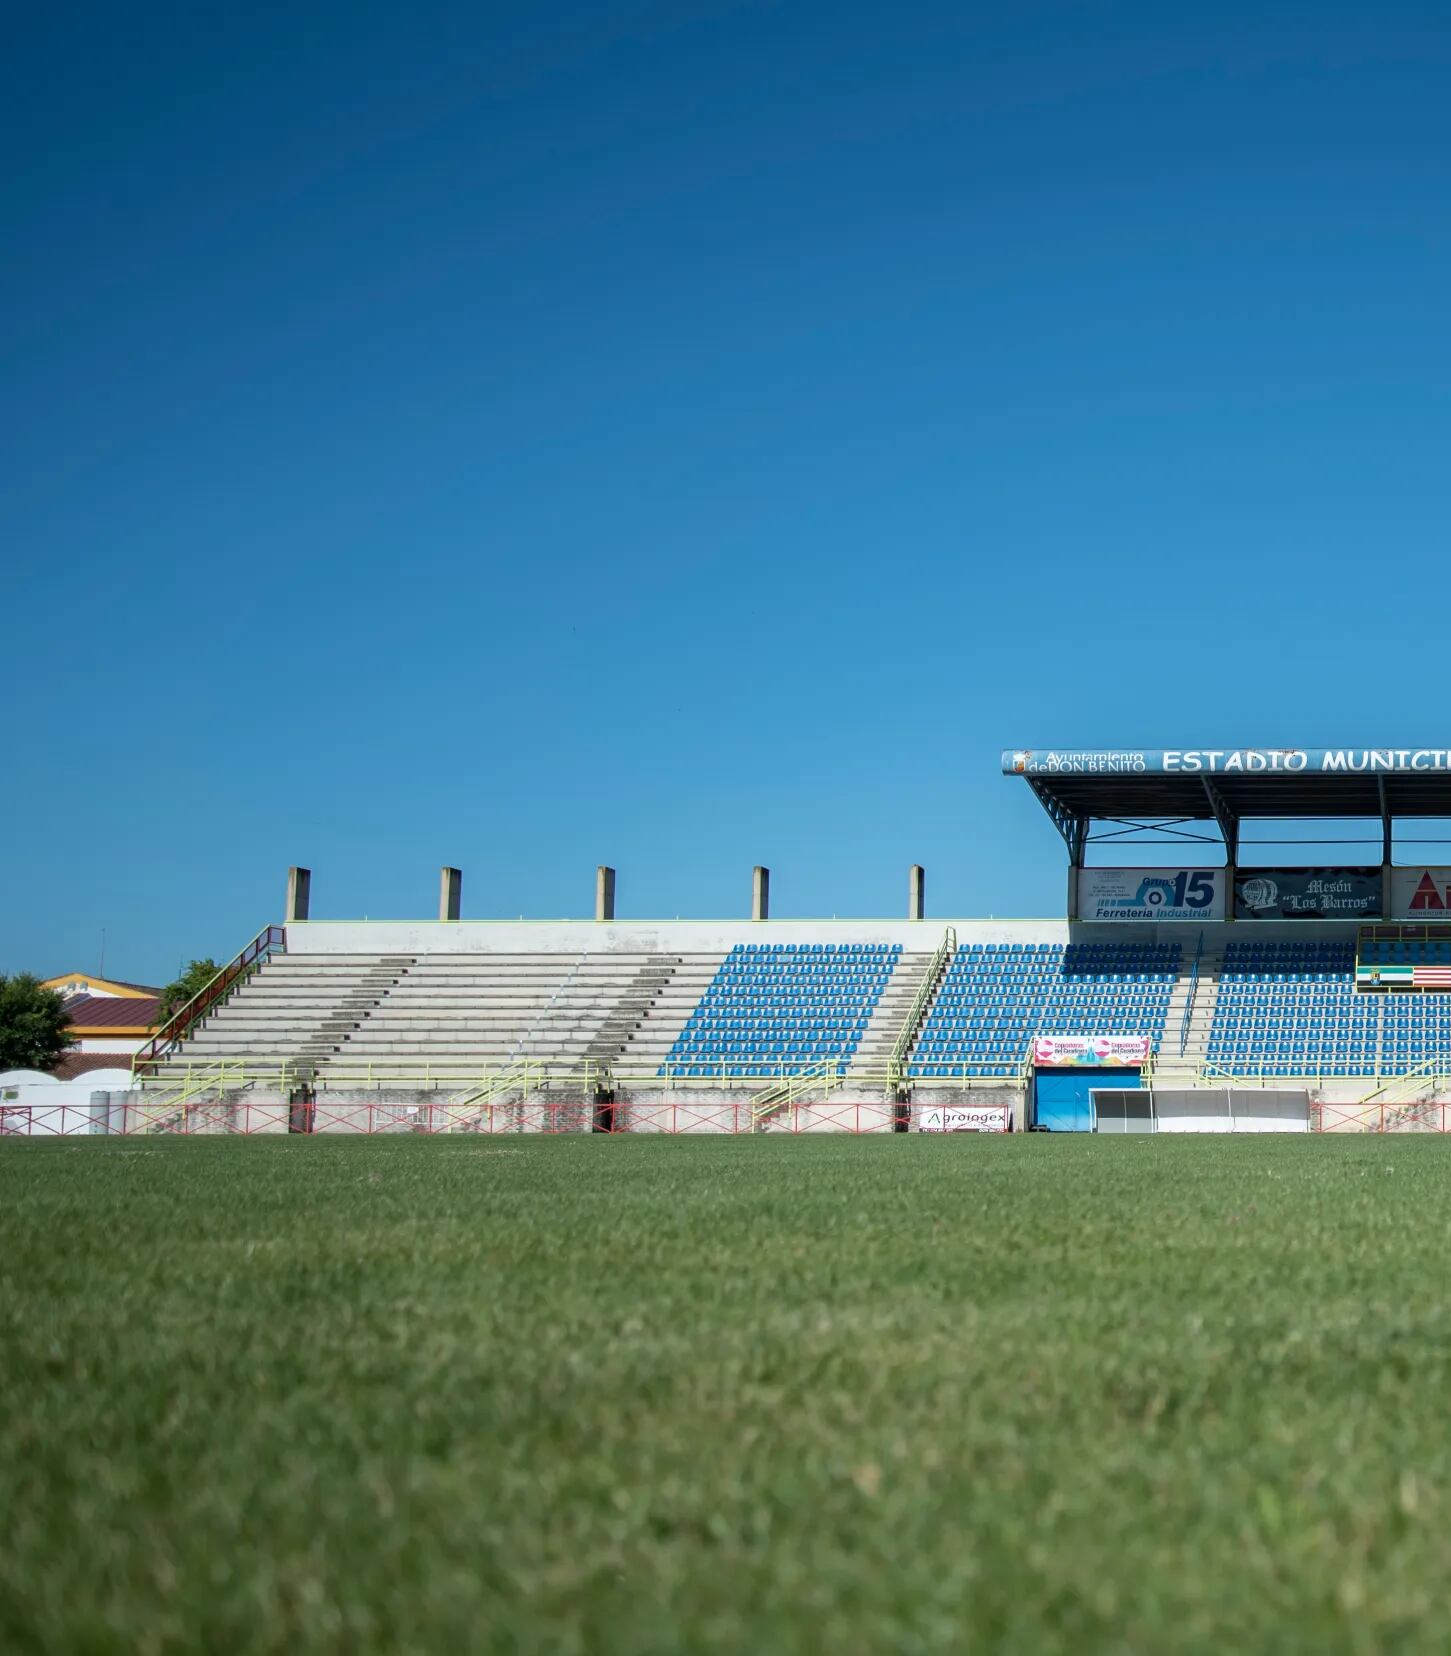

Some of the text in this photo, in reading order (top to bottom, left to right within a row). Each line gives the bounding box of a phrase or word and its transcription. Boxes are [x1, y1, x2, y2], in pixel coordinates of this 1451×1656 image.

[1088, 760, 1146, 773] BENITO
[1162, 750, 1308, 772] ESTADIO
[1173, 871, 1215, 908] 15
[1306, 879, 1352, 893] Mesón
[1156, 908, 1212, 918] Industrial
